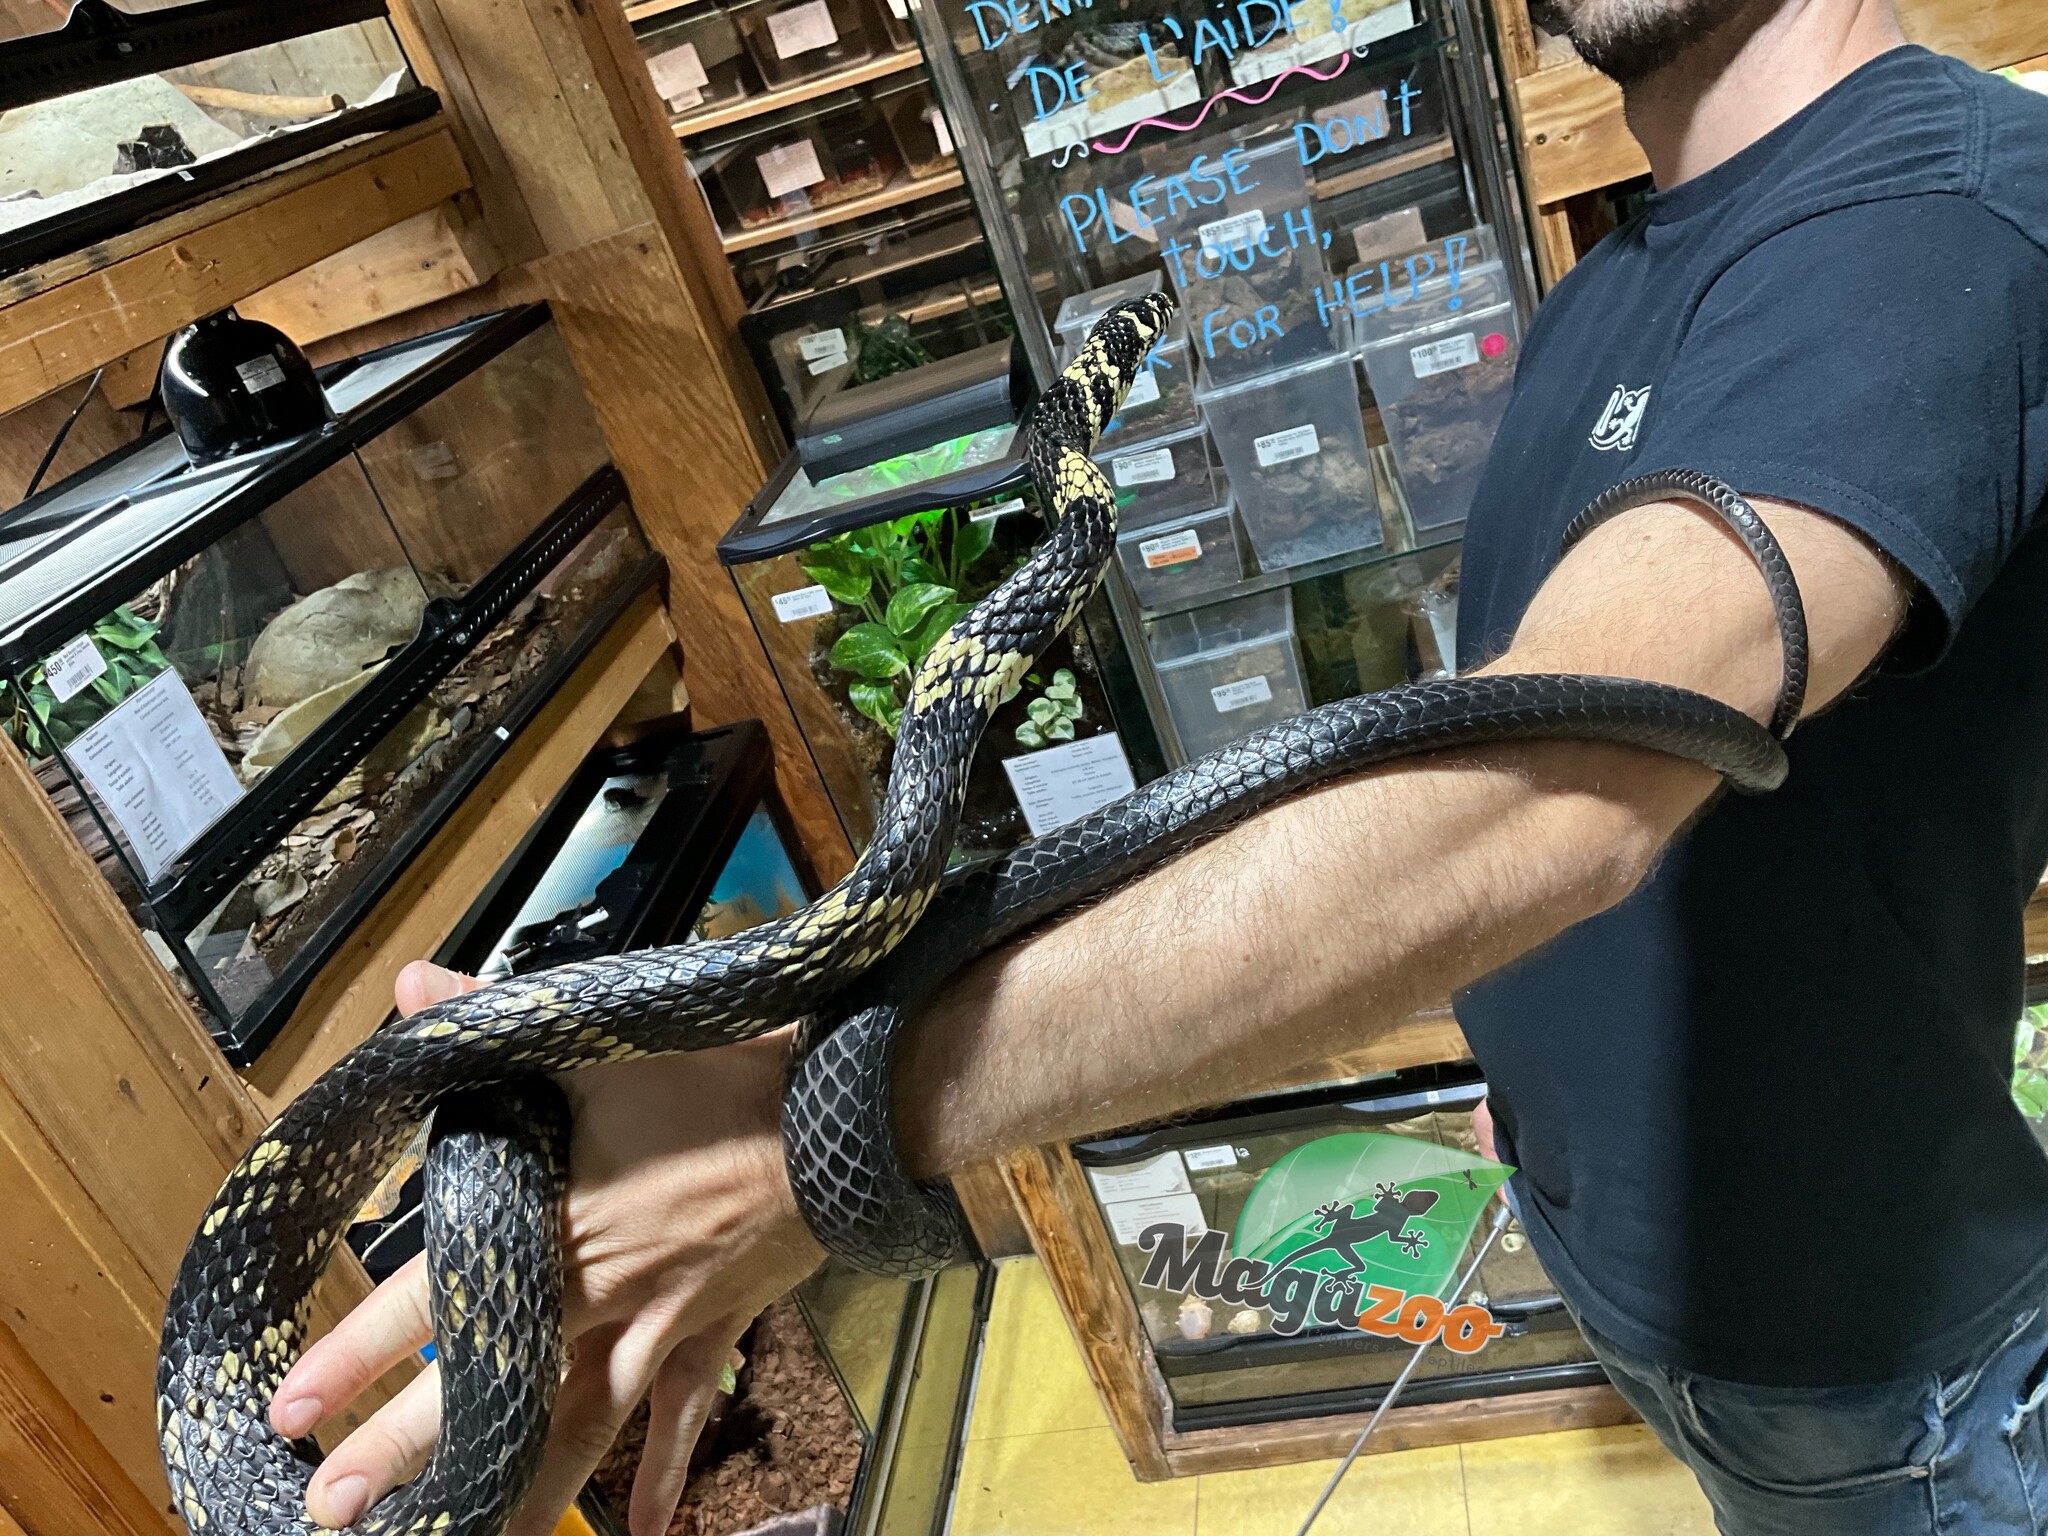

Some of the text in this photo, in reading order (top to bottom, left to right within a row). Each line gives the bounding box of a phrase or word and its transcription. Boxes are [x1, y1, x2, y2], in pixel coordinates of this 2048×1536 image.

[1025, 59, 1098, 120] DE
[1060, 148, 1261, 253] PLEASE
[1202, 237, 1468, 359] FOR HELP!
